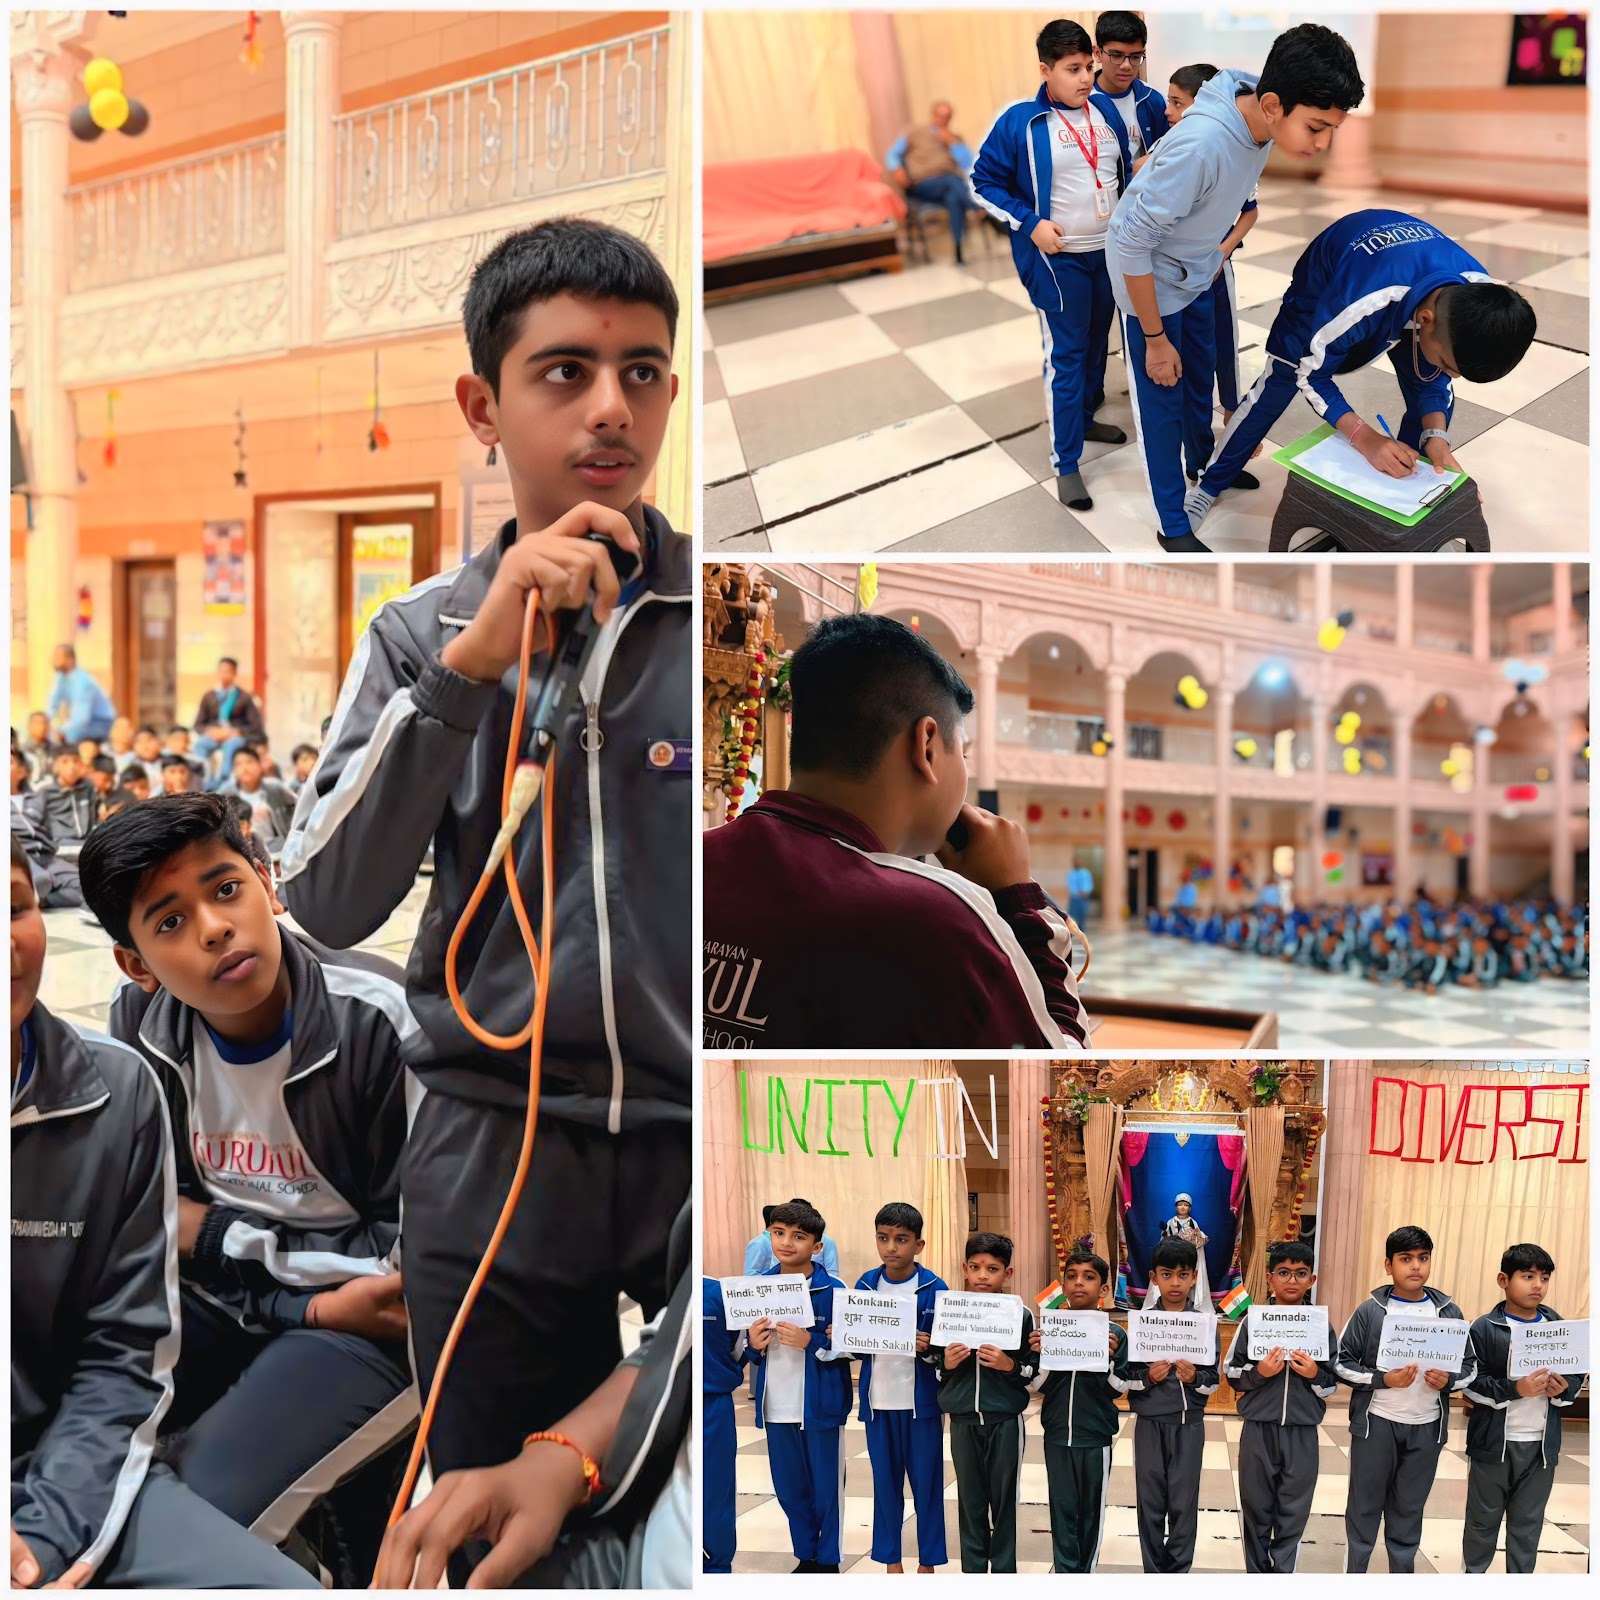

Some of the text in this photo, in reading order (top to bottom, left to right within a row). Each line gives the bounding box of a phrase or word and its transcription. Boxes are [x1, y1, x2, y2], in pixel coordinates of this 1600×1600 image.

[740, 1070, 1589, 1165] UNITY IN DIVERSI
[726, 1283, 803, 1299] Hindi: शुभ प्रभात
[847, 1295, 897, 1309] Konkani:
[942, 1297, 969, 1307] Tamil:
[730, 1306, 762, 1318] (Shubh
[764, 1305, 804, 1316] Prabhat)
[1262, 1312, 1310, 1322] Kannada:
[844, 1312, 901, 1327] शुभ सकाळ
[1040, 1315, 1077, 1327] Telugu:
[1139, 1316, 1197, 1327] Malayalam:
[938, 1322, 1014, 1336] (Kaalai Vanakkam)
[1394, 1324, 1466, 1336] Kashmiri & Urdu
[1526, 1327, 1570, 1339] Bengali:
[843, 1332, 914, 1352] (Shubh Sakal)
[1135, 1342, 1208, 1355] (Suprabhatham)
[1253, 1346, 1323, 1357] (Shhodaya)
[1381, 1347, 1457, 1362] (Subah Bakhair)
